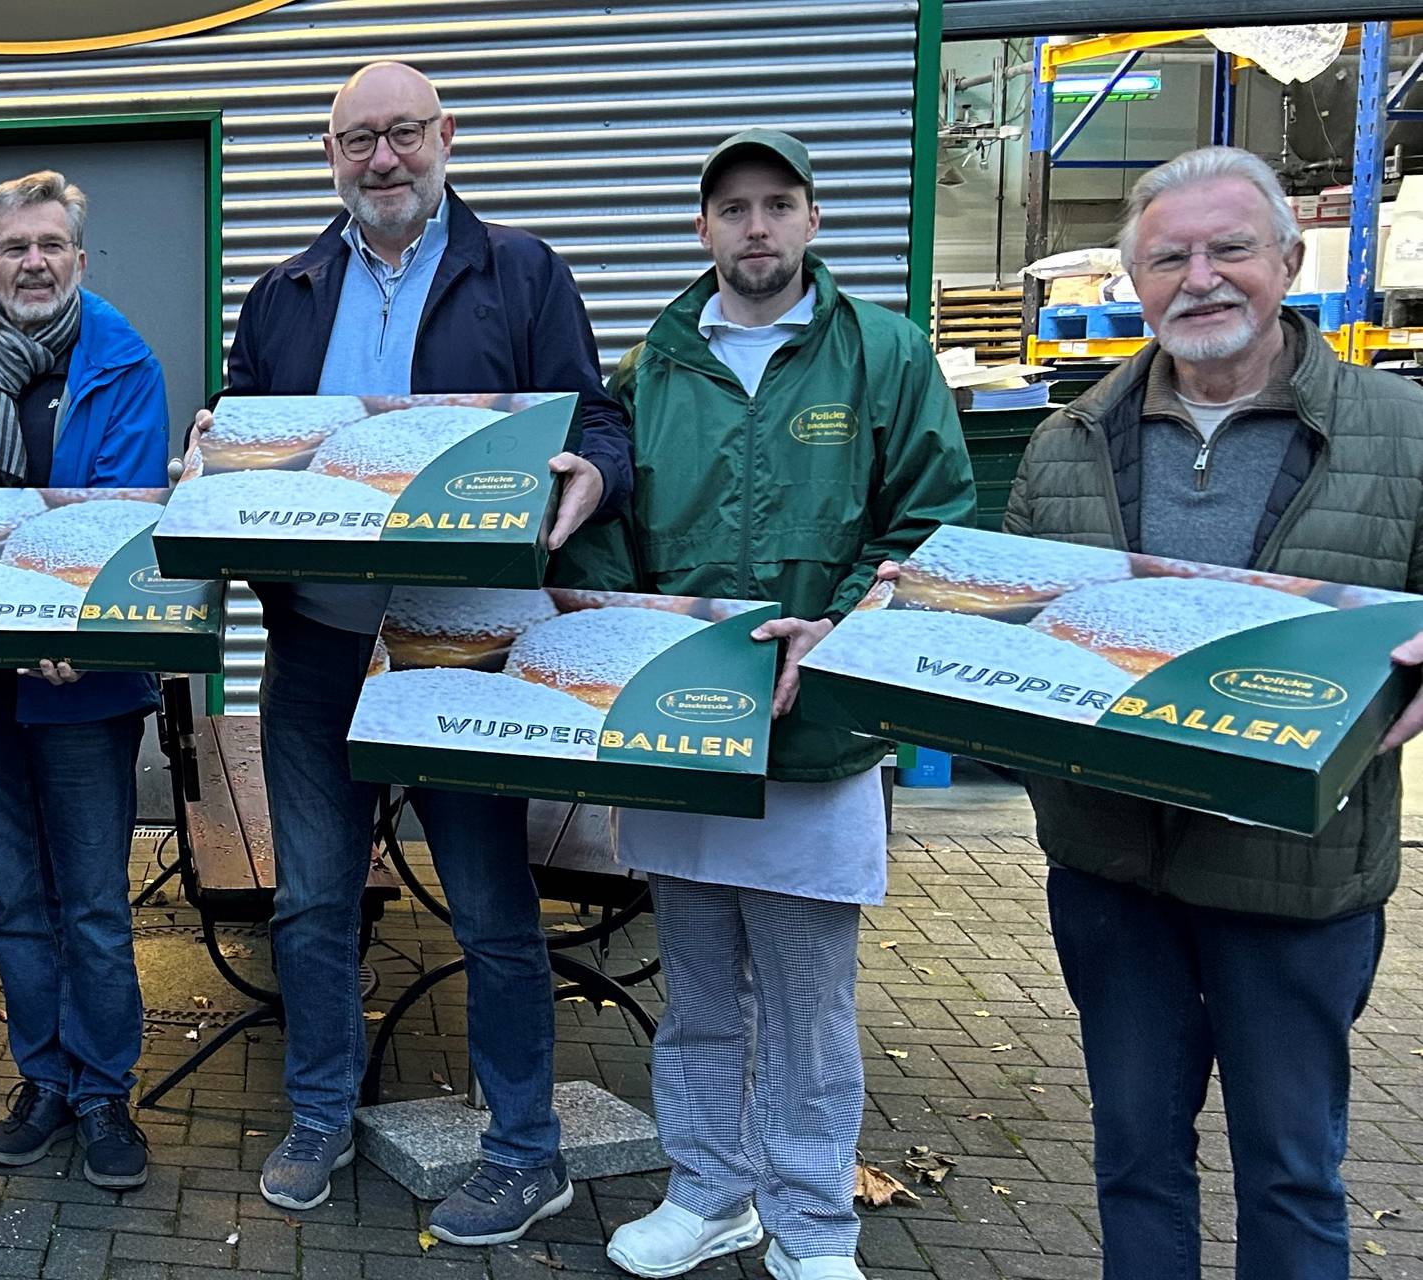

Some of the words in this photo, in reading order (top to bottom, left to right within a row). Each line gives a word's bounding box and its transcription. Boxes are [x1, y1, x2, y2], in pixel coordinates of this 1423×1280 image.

[238, 510, 530, 530] WUPPERBALLEN
[915, 655, 1322, 750] WUPPERBALLEN
[436, 715, 754, 758] WUPPERBALLEN
